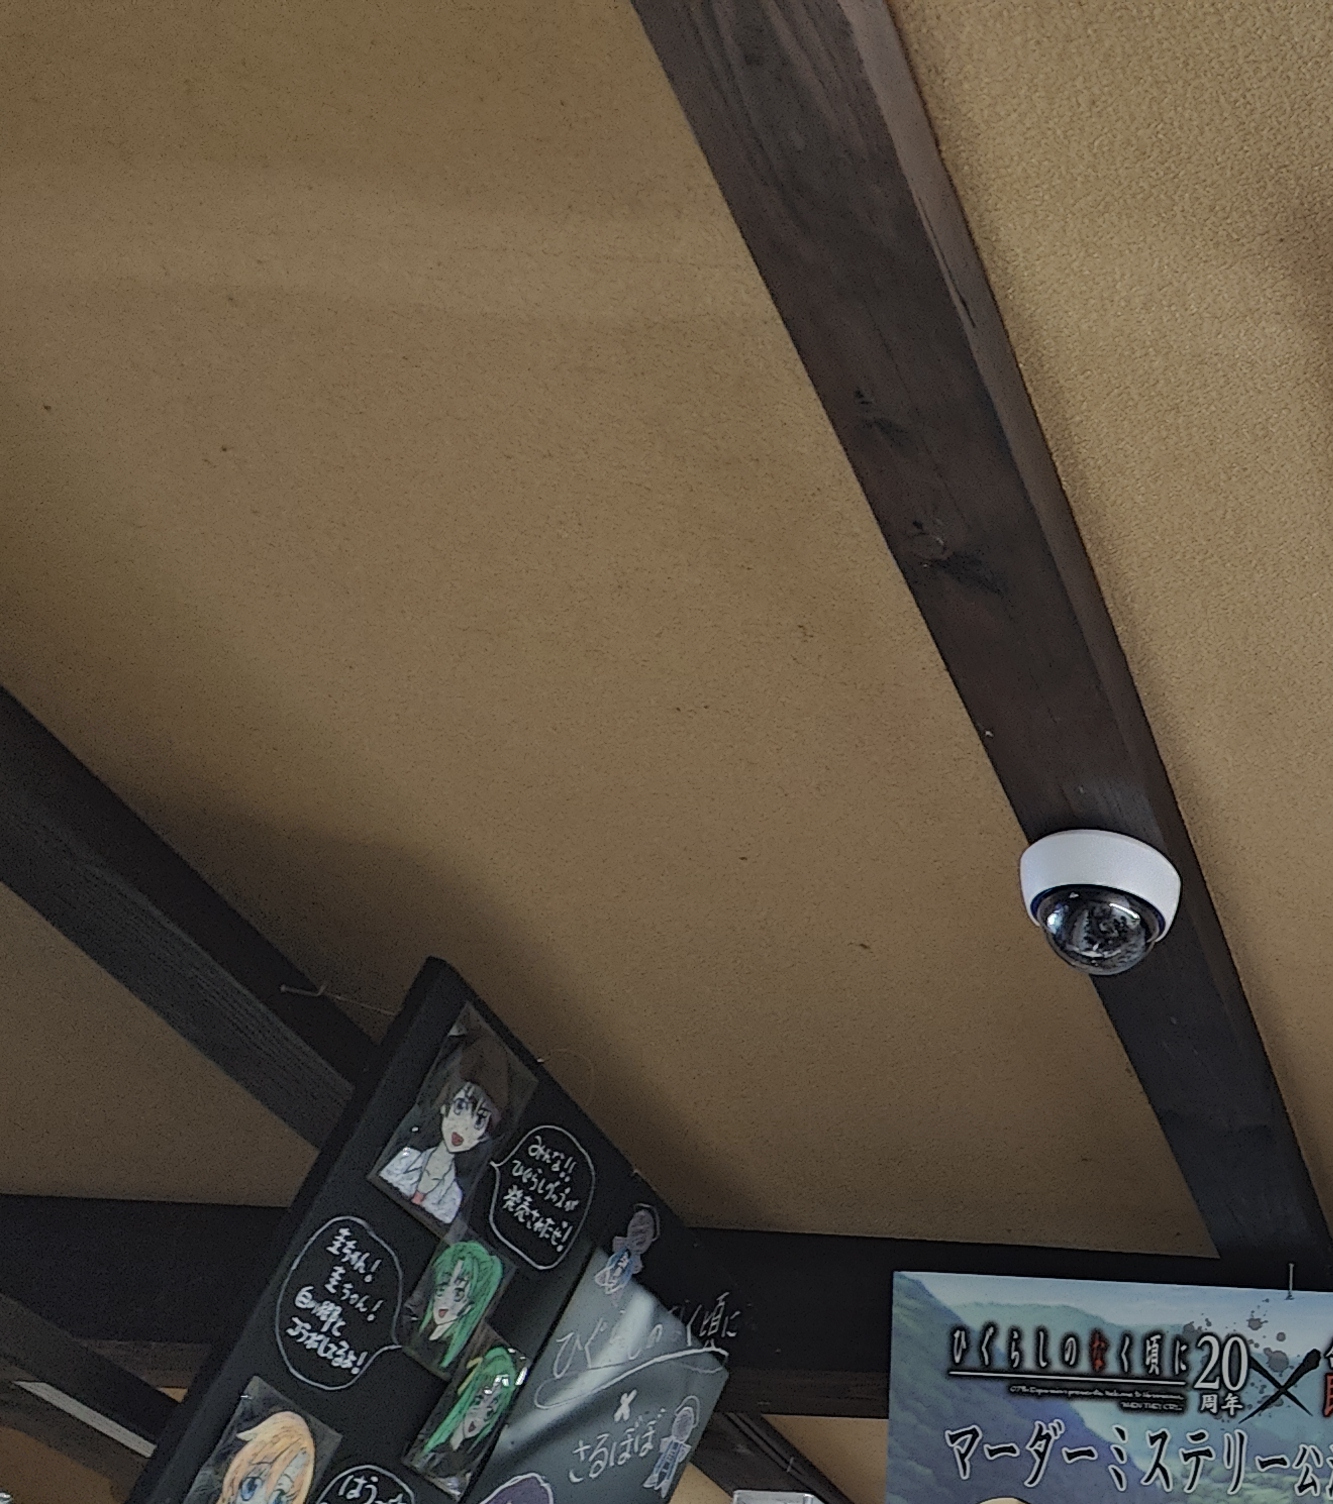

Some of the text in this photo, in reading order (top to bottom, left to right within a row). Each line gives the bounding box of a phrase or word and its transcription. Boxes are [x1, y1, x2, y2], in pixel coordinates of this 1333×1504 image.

[953, 1328, 1188, 1377] ひぐらしのなく頃に
[1194, 1334, 1250, 1392] 20
[1200, 1391, 1245, 1417] 周年
